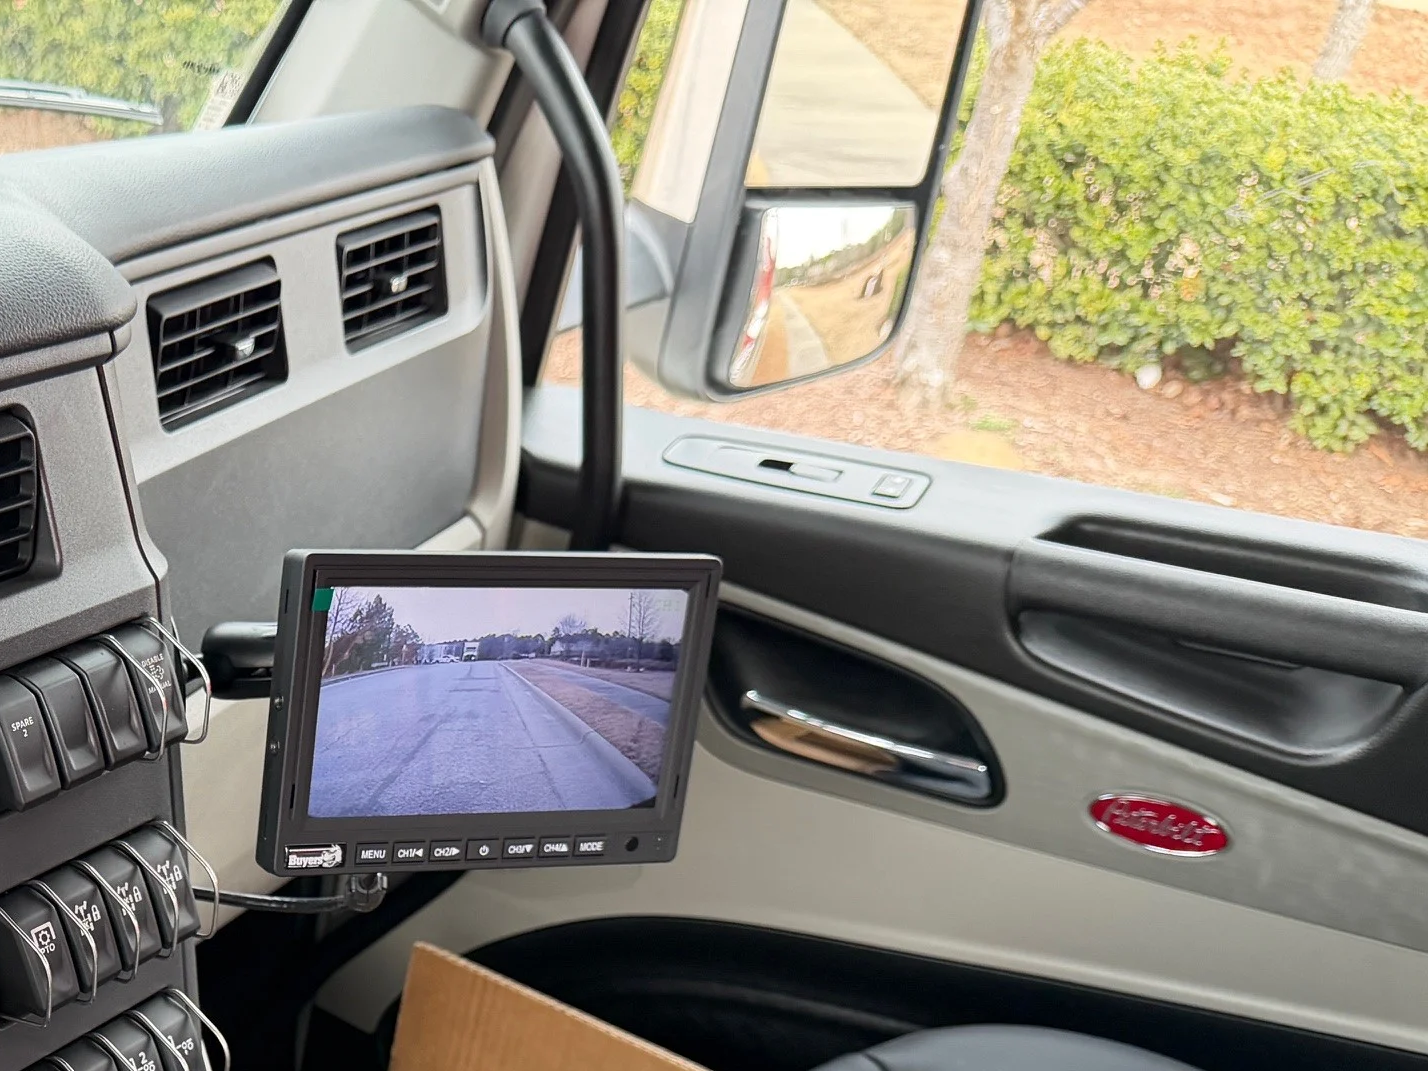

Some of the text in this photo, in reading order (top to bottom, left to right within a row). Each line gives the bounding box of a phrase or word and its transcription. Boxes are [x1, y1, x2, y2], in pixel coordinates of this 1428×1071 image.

[148, 680, 172, 694] MAUAL
[11, 716, 34, 731] SPARE
[579, 841, 604, 852] MODE
[361, 849, 386, 859] MENU
